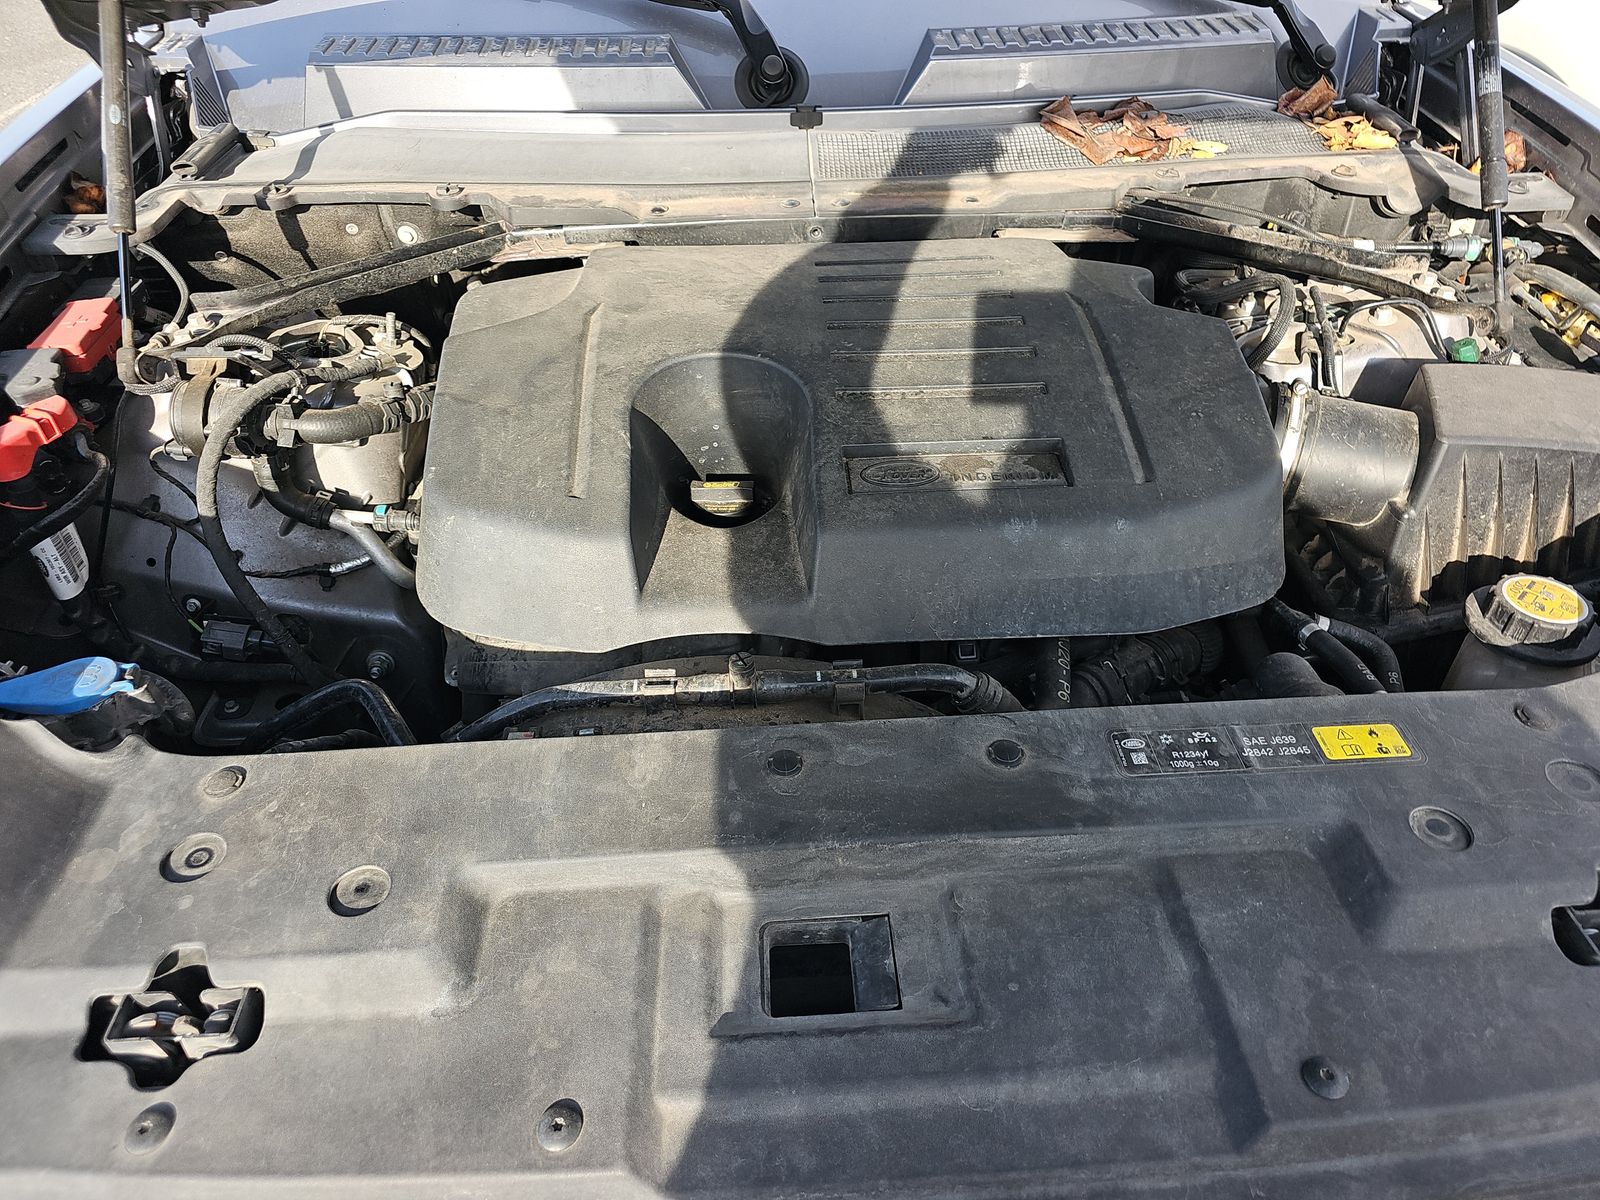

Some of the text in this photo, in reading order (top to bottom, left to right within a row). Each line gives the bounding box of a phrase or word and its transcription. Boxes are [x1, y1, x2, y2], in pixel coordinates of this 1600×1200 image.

[1243, 735, 1297, 746] SAE J639
[1171, 750, 1209, 760] R1234yf
[1241, 745, 1311, 757] J2842 J2845
[1169, 760, 1195, 768] 1000g
